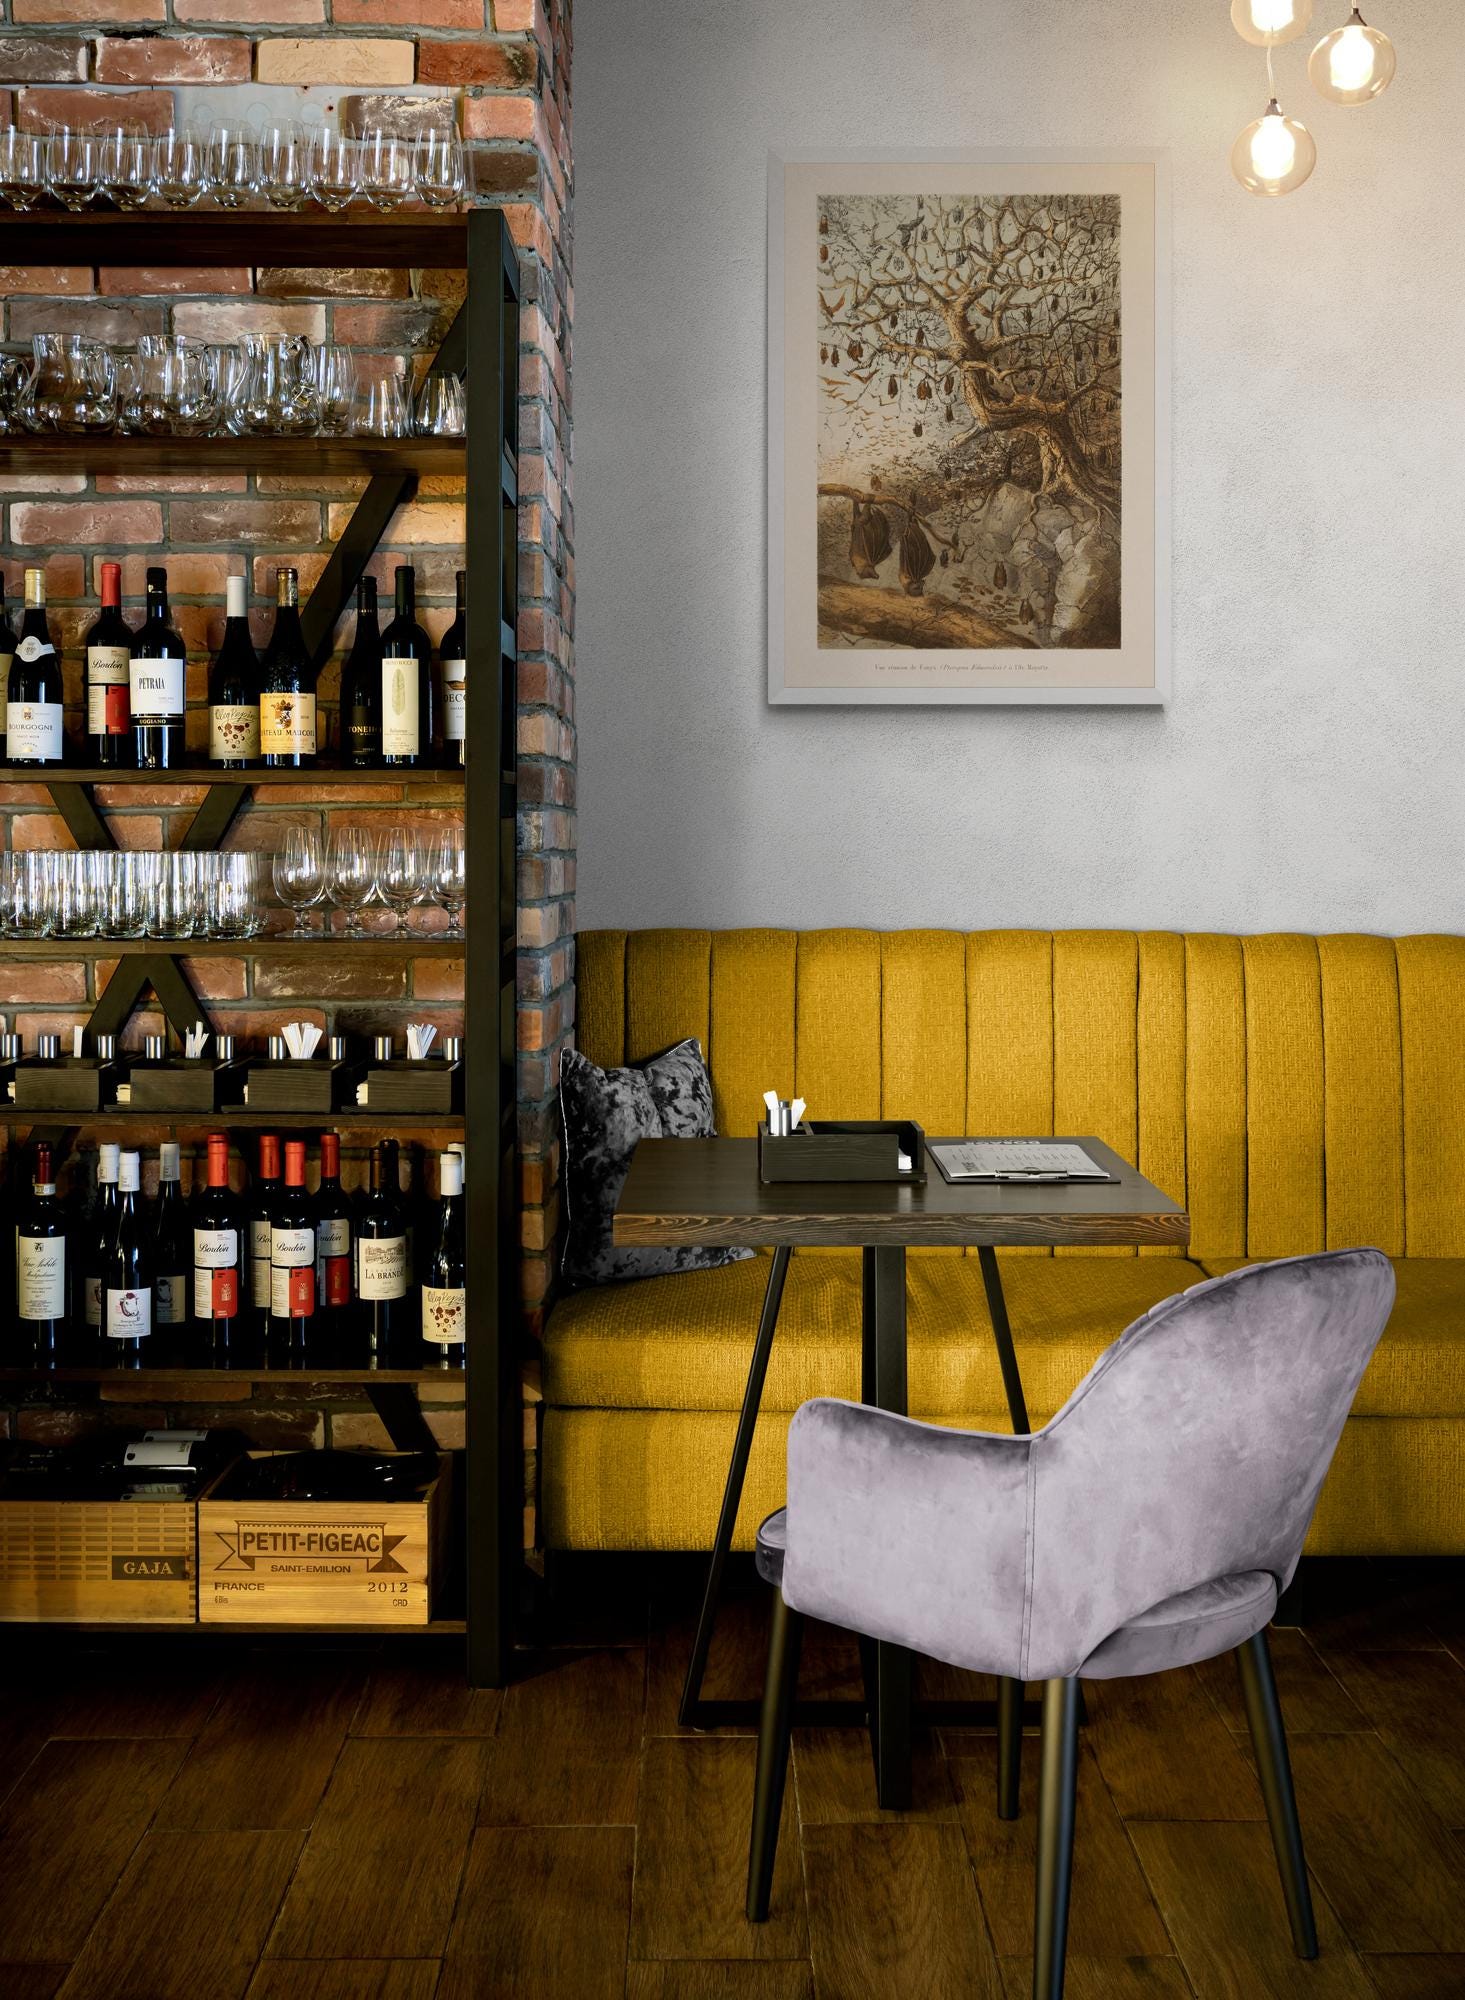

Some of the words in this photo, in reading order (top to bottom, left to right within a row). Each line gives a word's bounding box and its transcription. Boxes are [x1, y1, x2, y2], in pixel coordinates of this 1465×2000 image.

[138, 677, 165, 690] PETRAIA
[443, 693, 466, 703] DEC
[8, 723, 53, 731] BOURGOGNE
[199, 1241, 230, 1254] Bordón
[276, 1240, 307, 1253] Bordón
[365, 1268, 375, 1280] LA
[243, 1532, 380, 1553] PETIT-FIGEAC
[123, 1561, 174, 1575] GAJA
[270, 1564, 351, 1573] SAINT-EMILION
[214, 1582, 265, 1591] FRANCE
[367, 1582, 408, 1593] 2012
[392, 1599, 408, 1607] CRD
